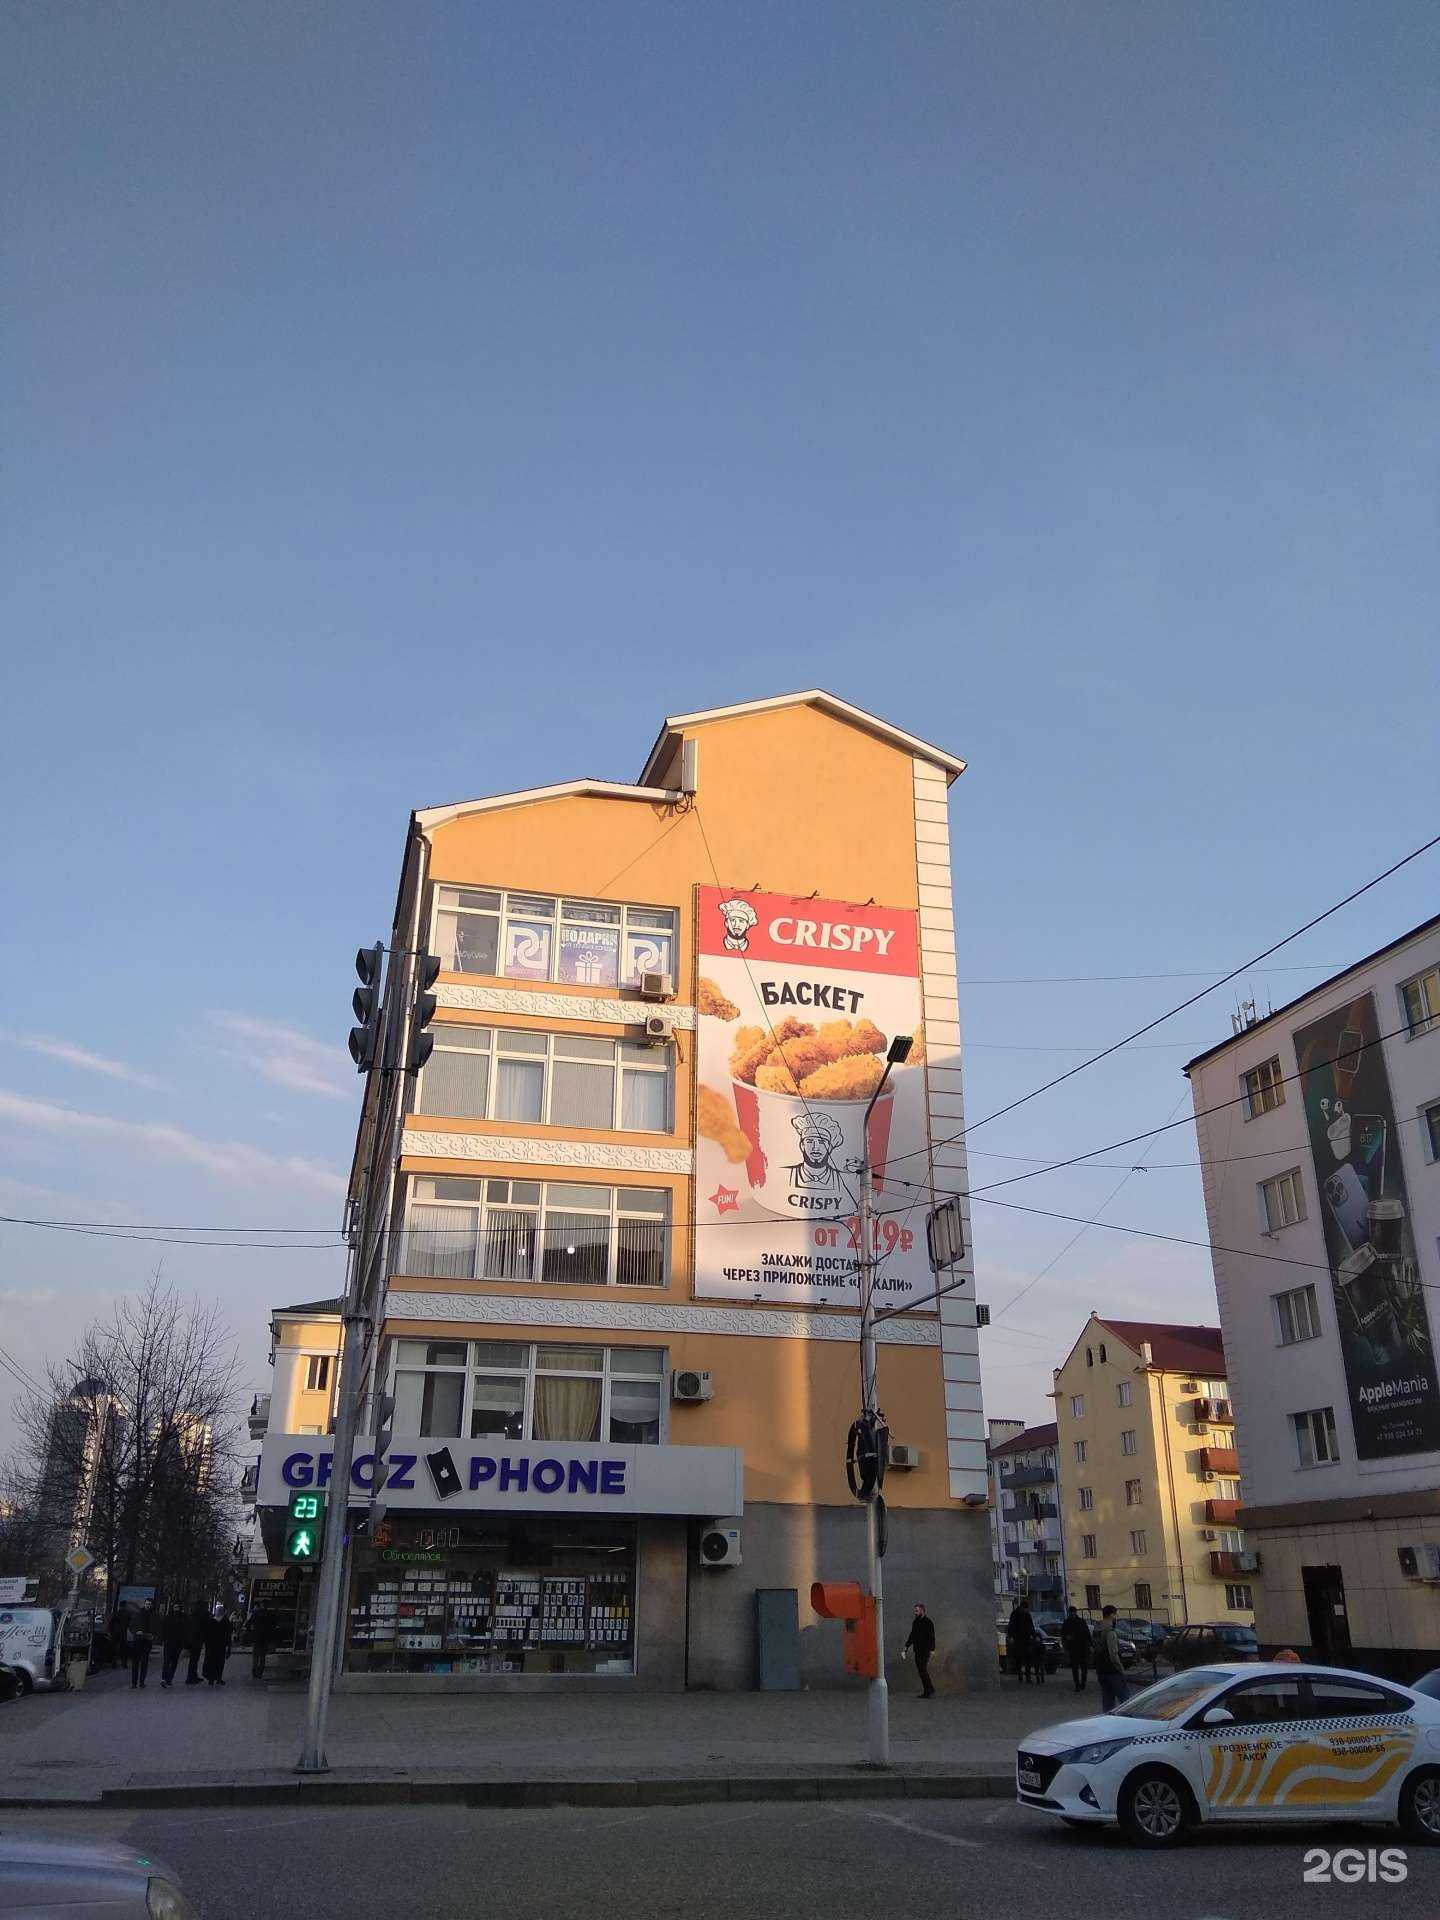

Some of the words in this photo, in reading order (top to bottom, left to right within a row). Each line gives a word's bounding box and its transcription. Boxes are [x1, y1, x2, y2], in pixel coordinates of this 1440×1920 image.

[768, 917, 896, 956] CRISPY
[760, 981, 865, 1015] БАСКЕТ
[717, 1194, 735, 1205] FUN!
[787, 1194, 843, 1211] CRISPY
[761, 1252, 813, 1268] ЗАКАЖИ
[723, 1267, 760, 1283] ЧЕРЕЗ
[763, 1270, 846, 1288] ПРИЛОЖЕНИЕ
[1359, 1375, 1429, 1404] AppleMania
[469, 1456, 627, 1495] PHONE
[294, 1498, 317, 1519] 23
[1218, 1740, 1283, 1753] ГРОЗНЕНСКОЕ
[1237, 1751, 1268, 1762] ТАКСИ
